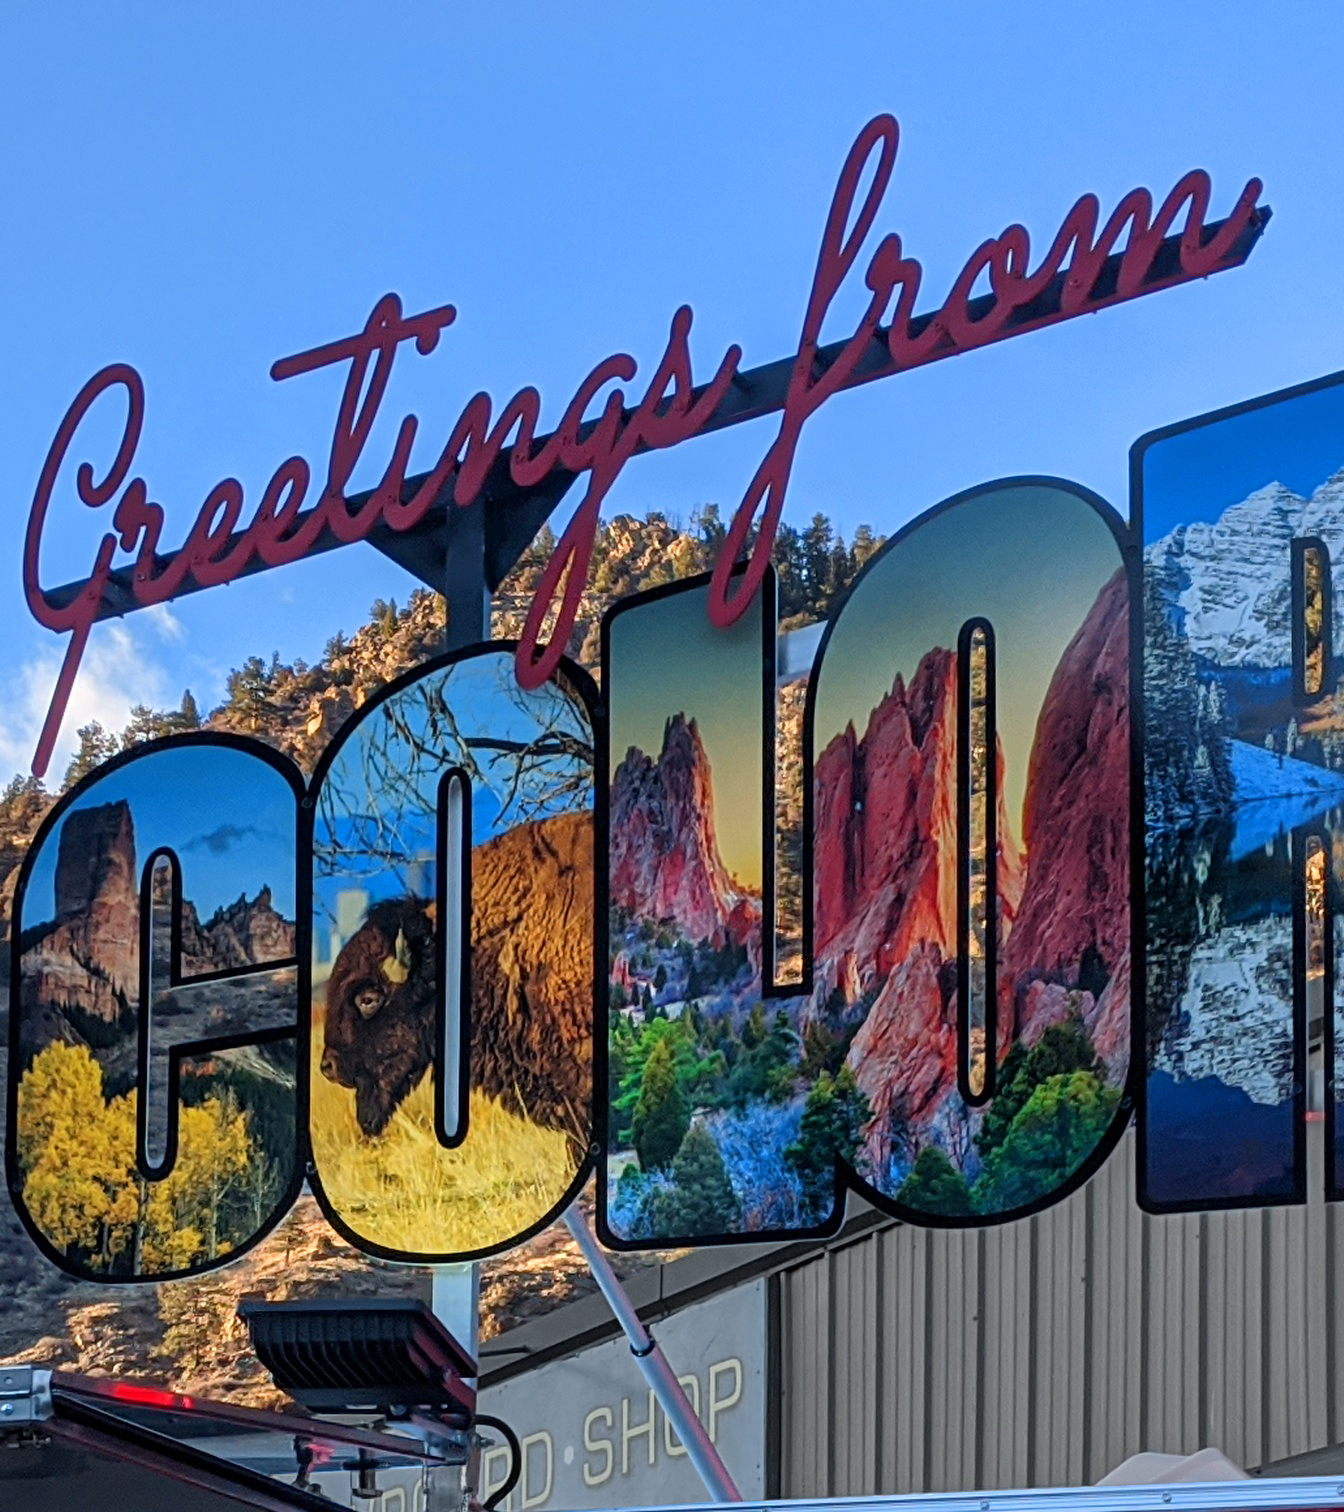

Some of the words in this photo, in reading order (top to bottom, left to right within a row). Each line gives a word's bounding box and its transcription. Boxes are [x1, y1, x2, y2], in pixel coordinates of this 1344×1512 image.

[24, 291, 743, 778] Greetings
[706, 112, 1264, 628] from
[582, 1357, 744, 1486] SHOP
